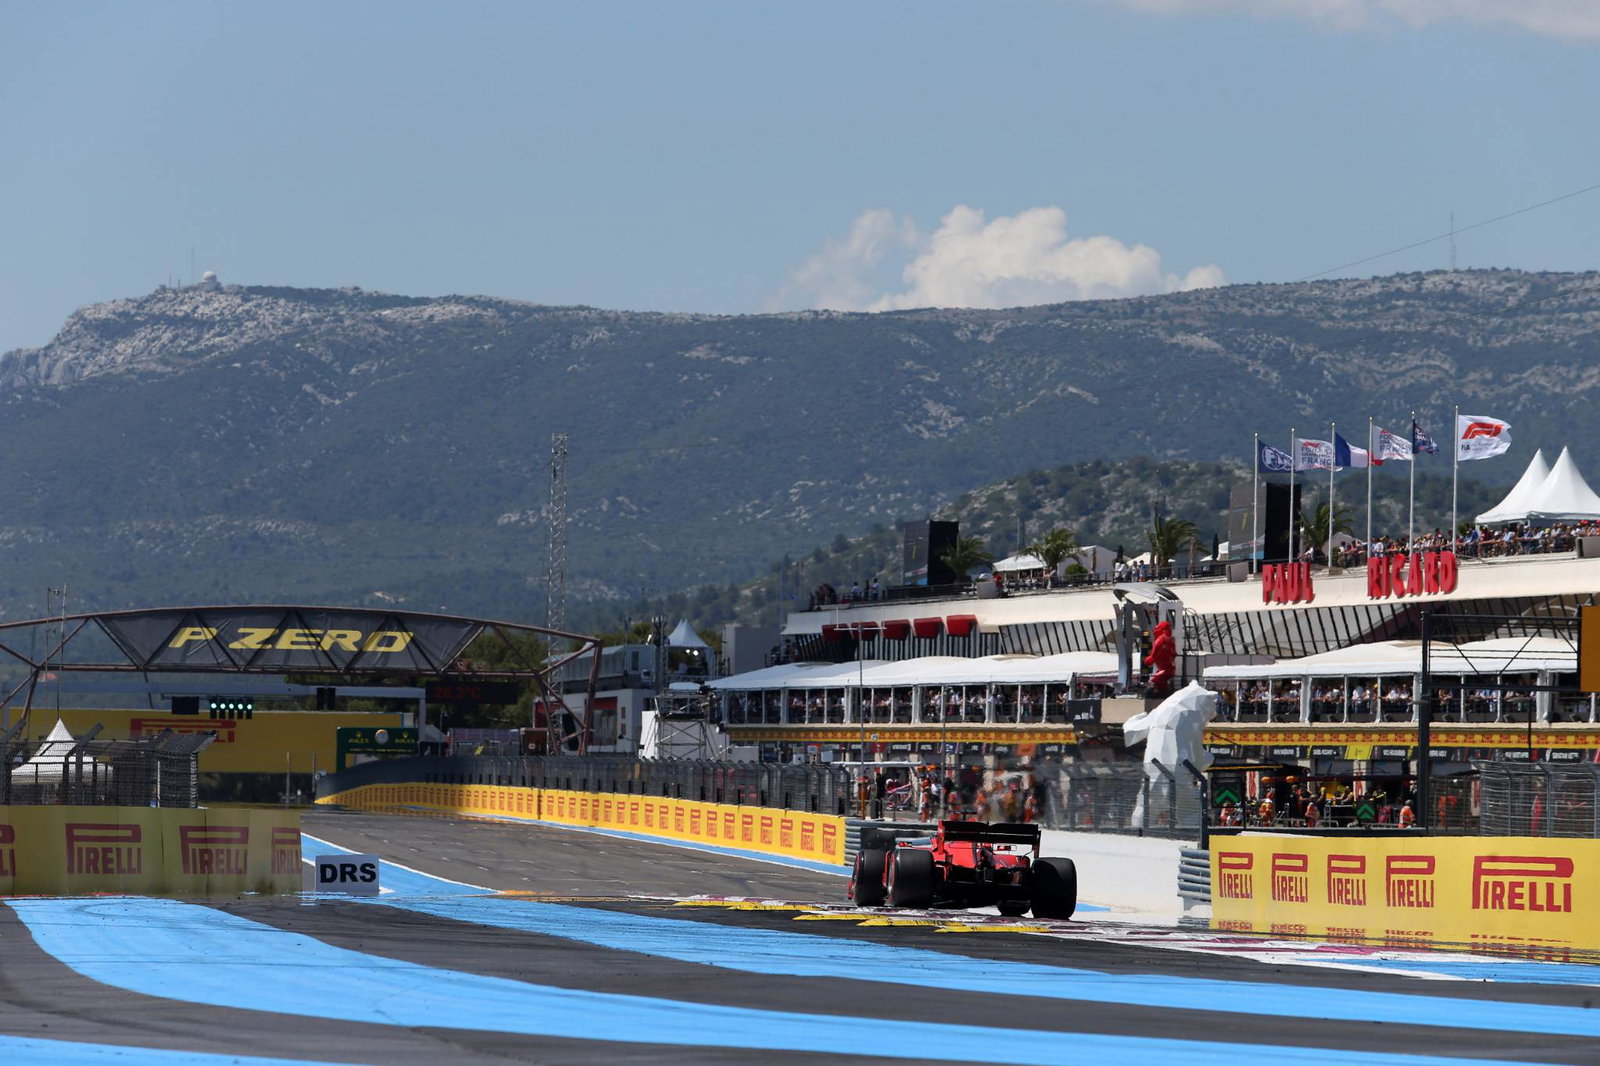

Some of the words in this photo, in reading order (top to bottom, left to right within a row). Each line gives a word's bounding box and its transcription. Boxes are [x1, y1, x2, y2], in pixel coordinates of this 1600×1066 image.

[1301, 457, 1332, 466] FRANC
[1262, 562, 1315, 604] PAUL
[1367, 551, 1458, 600] RICARD
[168, 627, 218, 649] P
[228, 628, 415, 652] ZERO
[65, 823, 142, 875] PIRELLI
[179, 826, 250, 875] PIRELLI
[319, 862, 377, 883] DRS
[1218, 851, 1253, 899] PIRELLI
[1272, 853, 1308, 904] PIRELLI
[1327, 854, 1366, 906] PIRELLI
[1386, 855, 1436, 908] PIRELLI
[1471, 856, 1574, 913] PIRELLI
